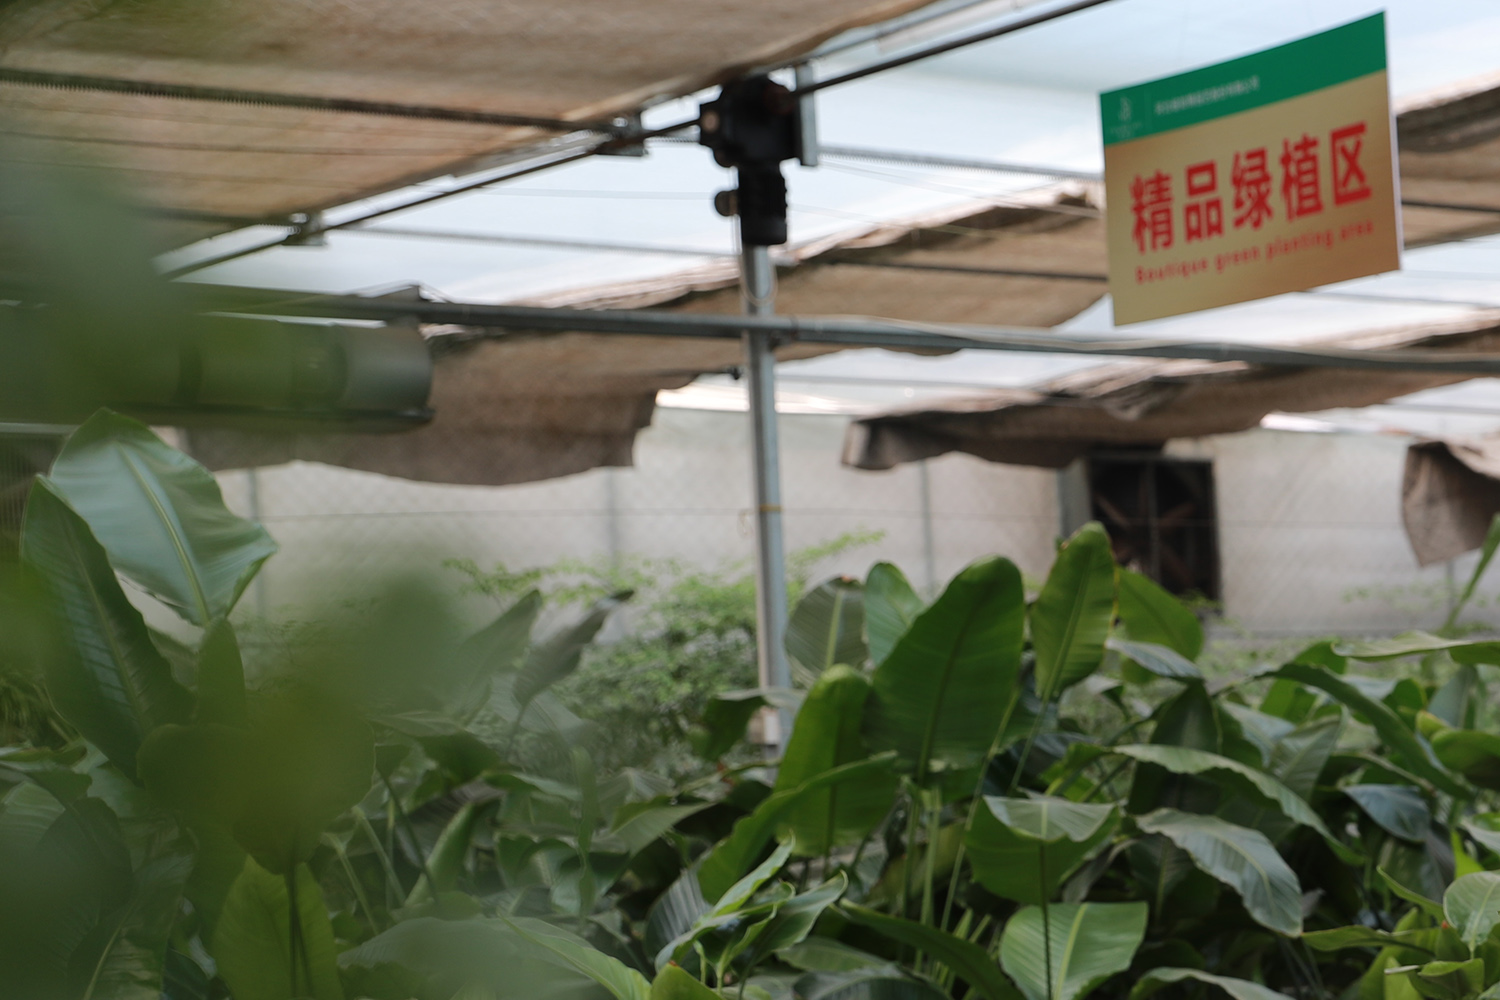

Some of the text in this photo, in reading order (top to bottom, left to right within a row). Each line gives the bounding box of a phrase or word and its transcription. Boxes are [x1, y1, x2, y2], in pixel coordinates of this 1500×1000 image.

[1130, 121, 1372, 255] 精品绿植区
[1135, 221, 1374, 284] Boutique green planting area
